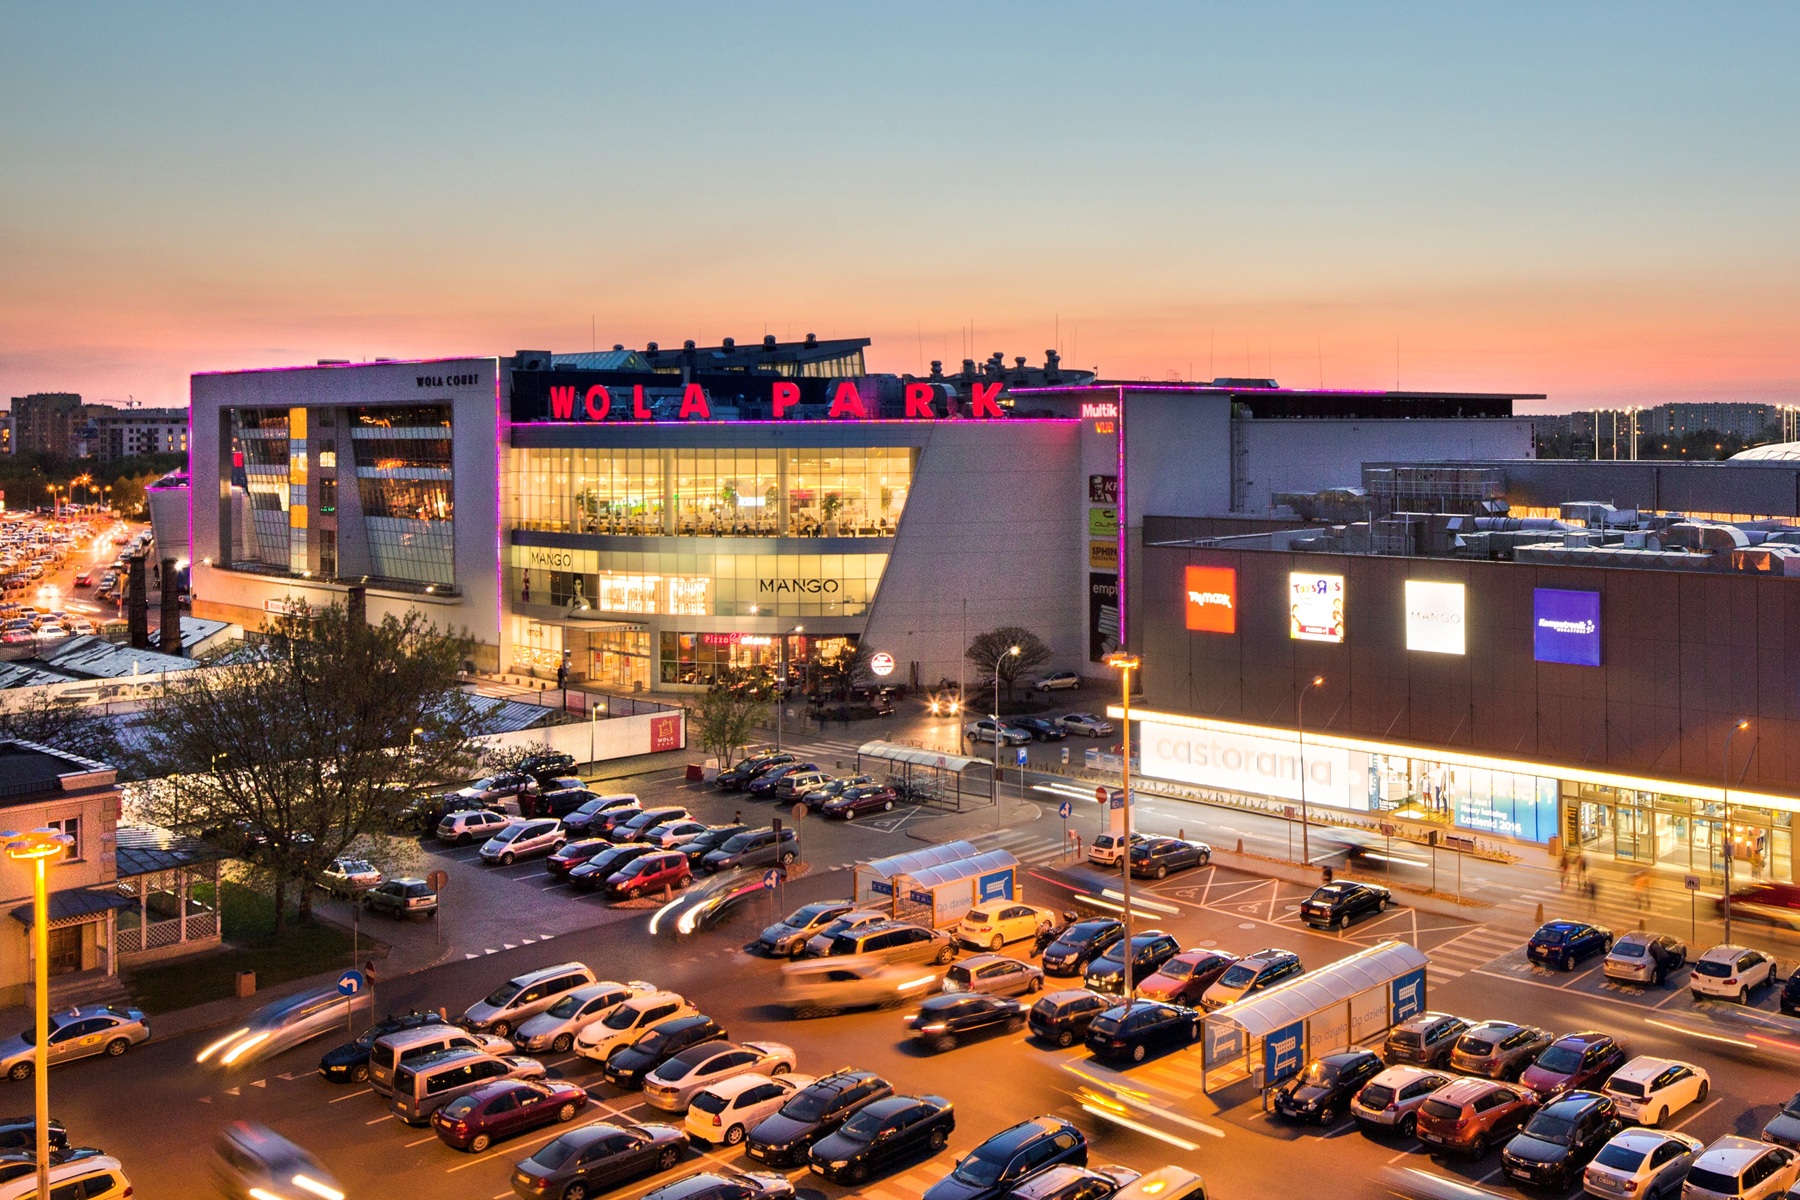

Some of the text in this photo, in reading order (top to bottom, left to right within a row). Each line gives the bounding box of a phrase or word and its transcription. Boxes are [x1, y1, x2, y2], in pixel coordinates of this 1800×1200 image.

[416, 374, 478, 387] WOLA COURT
[550, 382, 1004, 420] WOLA PARK
[531, 552, 572, 567] MANGO
[760, 579, 839, 593] MANGO
[1411, 611, 1461, 625] MANGO
[705, 634, 729, 644] Pizza
[1156, 737, 1332, 787] castorama
[1498, 820, 1522, 833] 2016
[936, 902, 948, 913] Do
[1351, 1017, 1363, 1028] Do
[1310, 1035, 1322, 1046] Do
